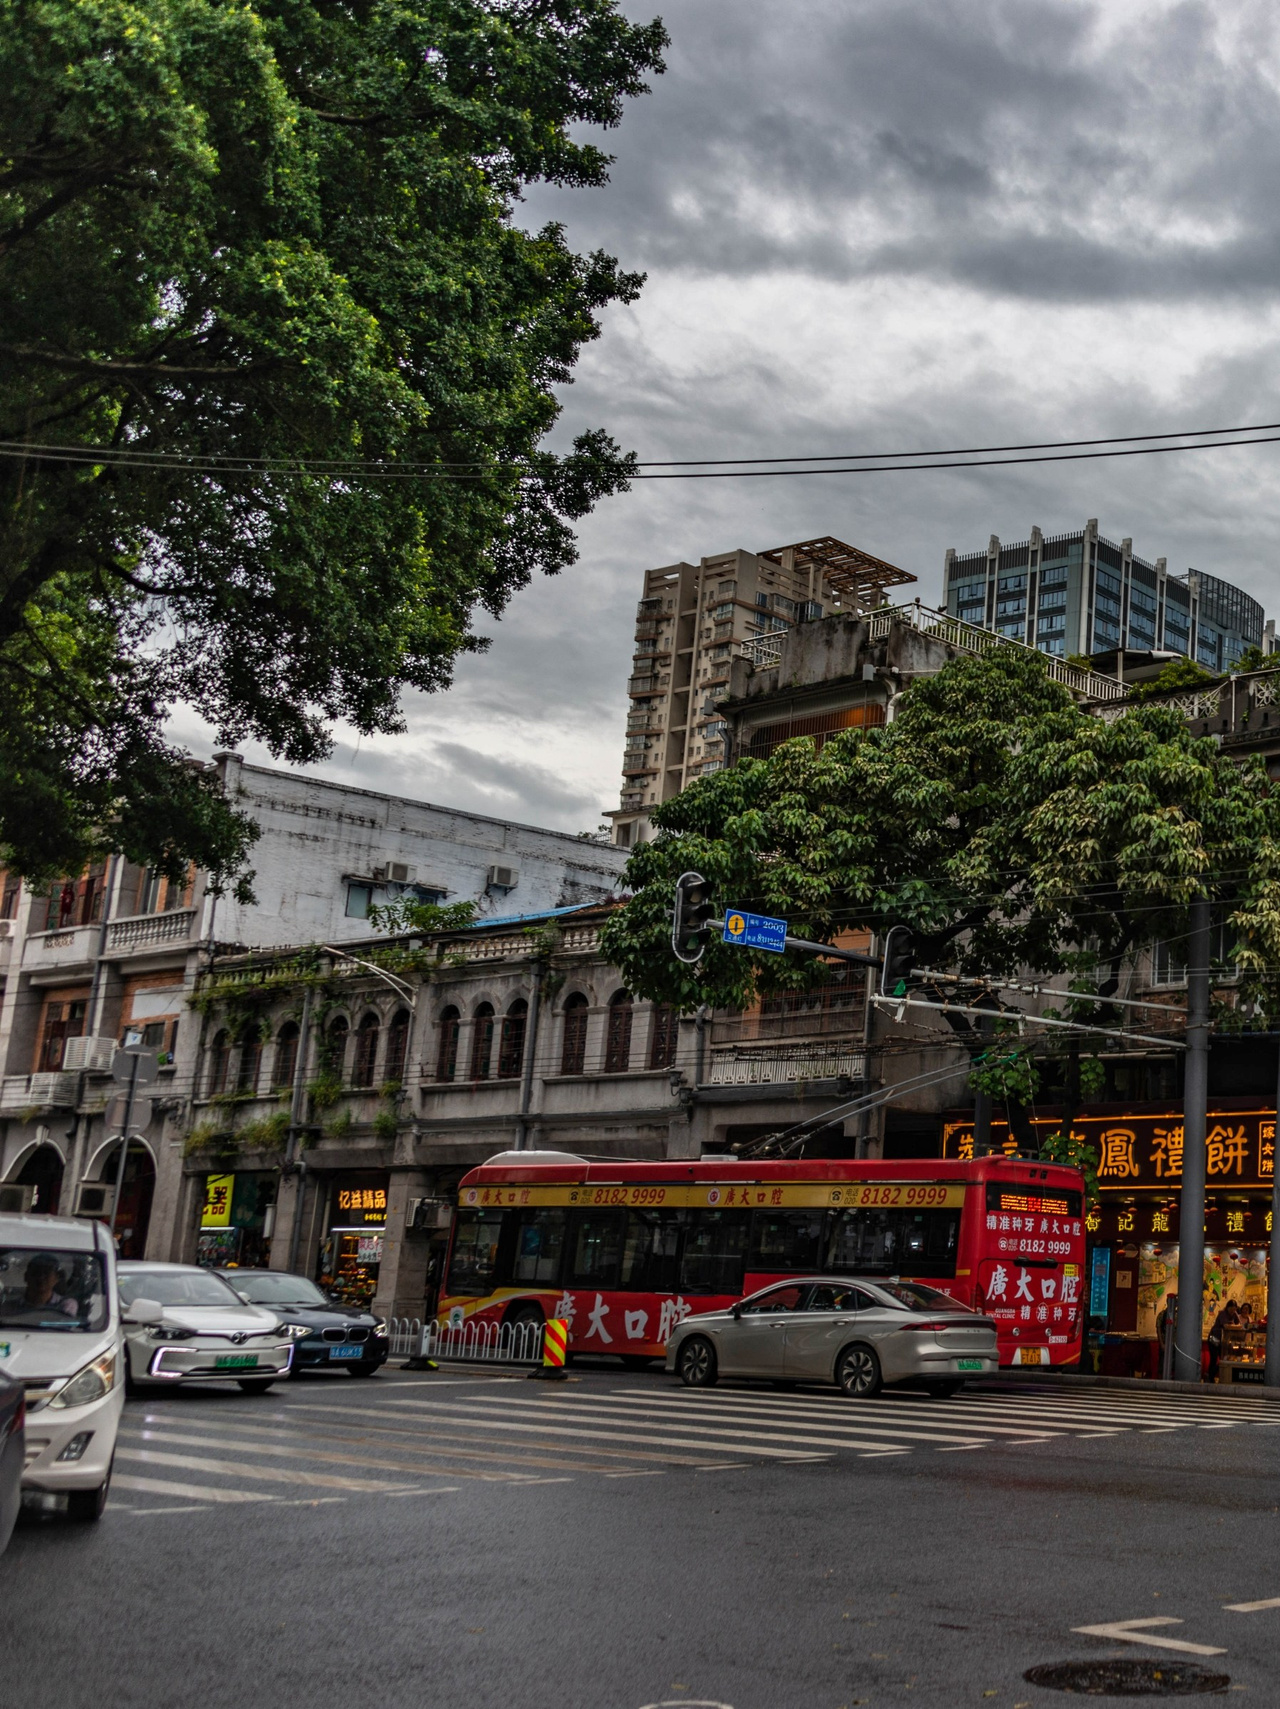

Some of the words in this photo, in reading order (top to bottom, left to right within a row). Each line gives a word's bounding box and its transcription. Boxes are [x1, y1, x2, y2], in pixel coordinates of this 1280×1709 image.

[763, 920, 784, 933] 2003
[338, 1189, 387, 1210] 亿益精品
[594, 1188, 628, 1204] 8182
[631, 1188, 666, 1204] 9999
[861, 1187, 901, 1205] 8182
[905, 1187, 947, 1205] 9999
[986, 1215, 1034, 1233] 精准种牙
[1019, 1239, 1045, 1253] 8182
[1047, 1241, 1071, 1255] 9999
[986, 1264, 1080, 1303] 廣大口腔
[554, 1290, 692, 1343] 廣大口腔
[1020, 1304, 1077, 1322] 精准种牙
